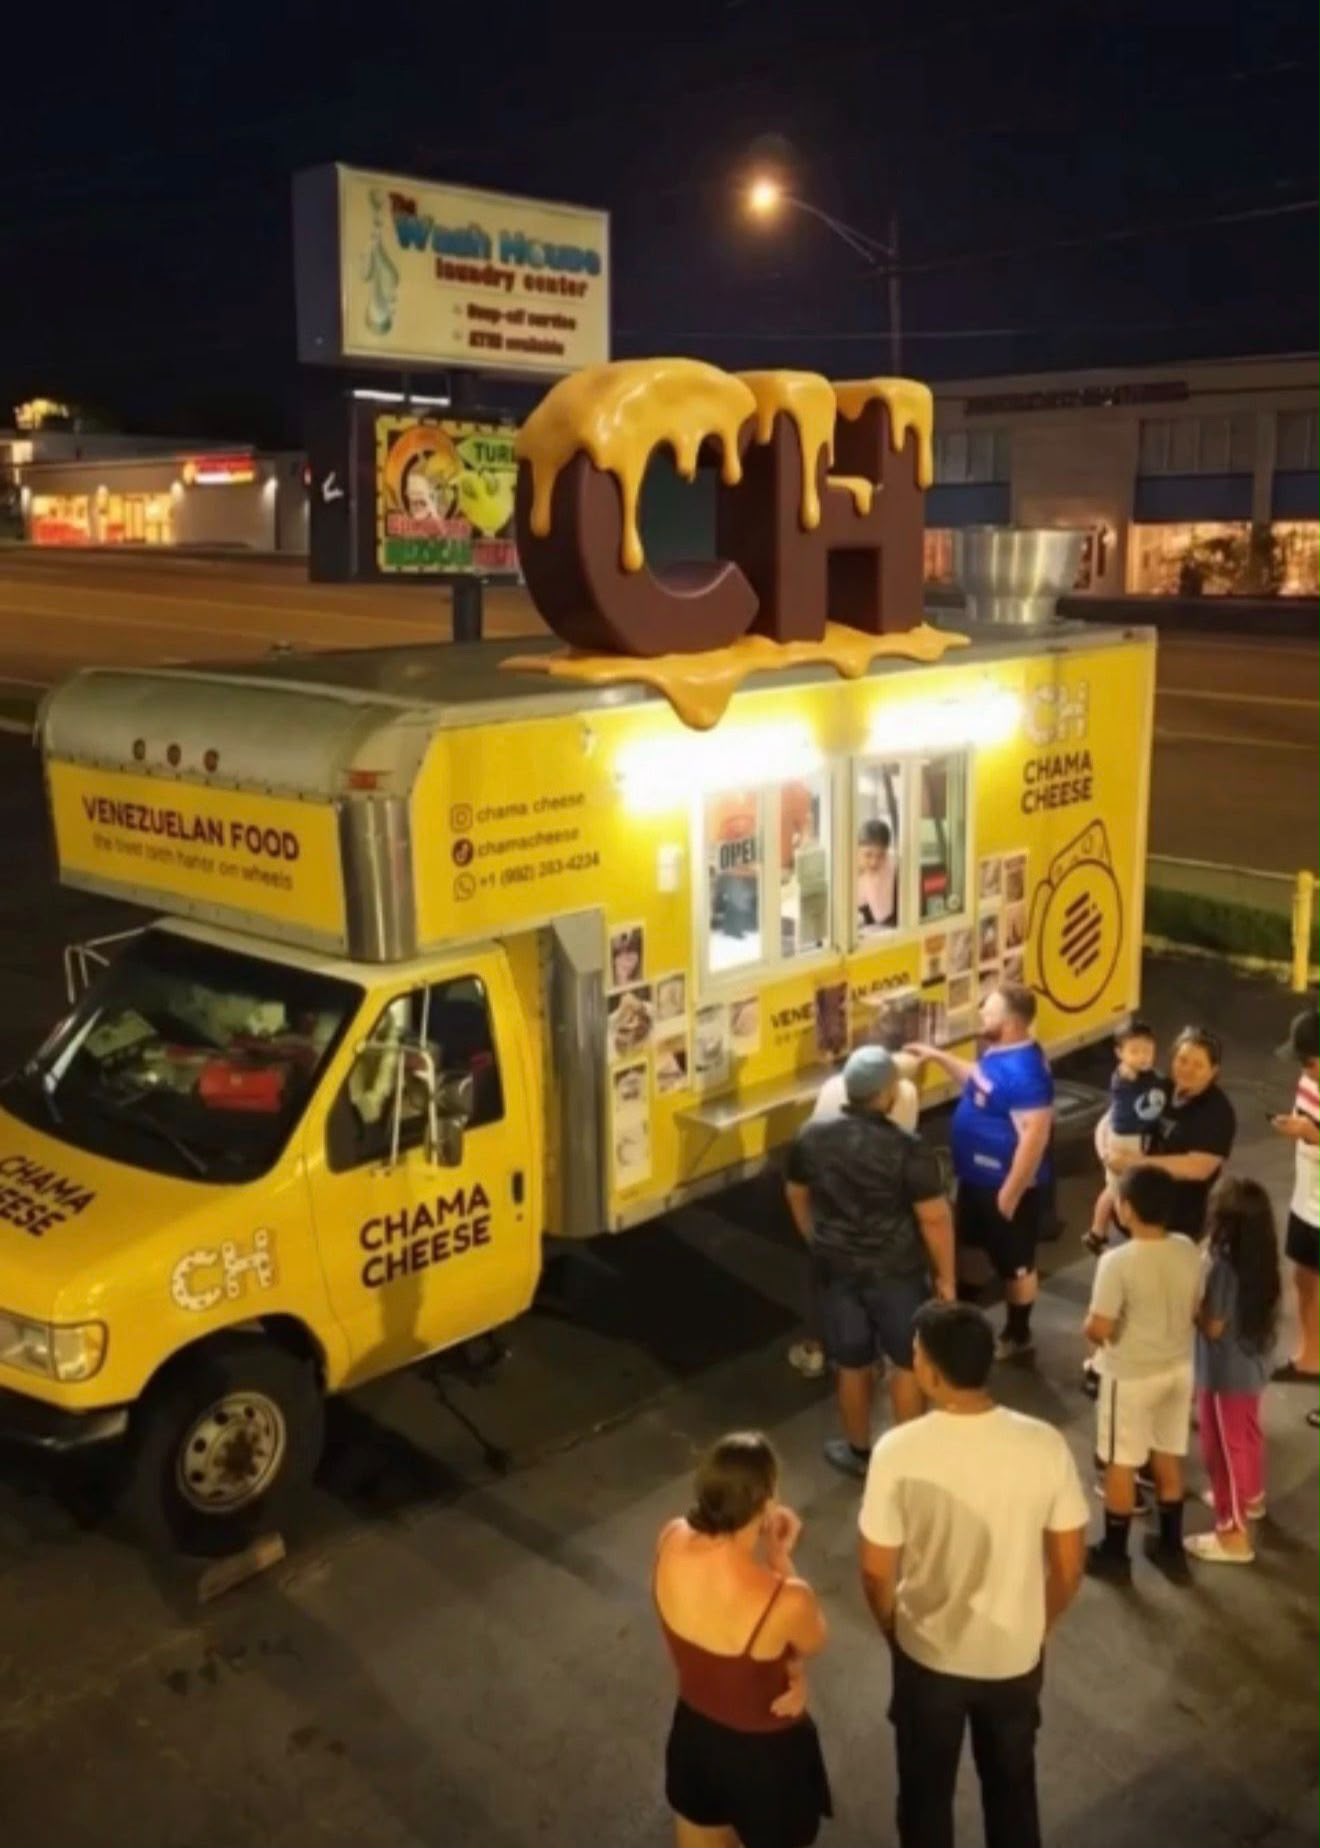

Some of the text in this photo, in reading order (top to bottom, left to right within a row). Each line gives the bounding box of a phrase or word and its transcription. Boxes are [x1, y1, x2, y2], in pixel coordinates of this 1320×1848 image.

[436, 257, 589, 298] laundry center
[1020, 776, 1093, 815] CHEESE
[1023, 750, 1093, 784] CHAMA
[82, 796, 225, 847] VENEZUELAN
[230, 825, 301, 861] FOOD
[0, 1155, 97, 1215] CHAMA
[359, 1182, 491, 1251] CHAMA
[172, 1227, 274, 1311] CH
[361, 1214, 491, 1289] CHEESE
